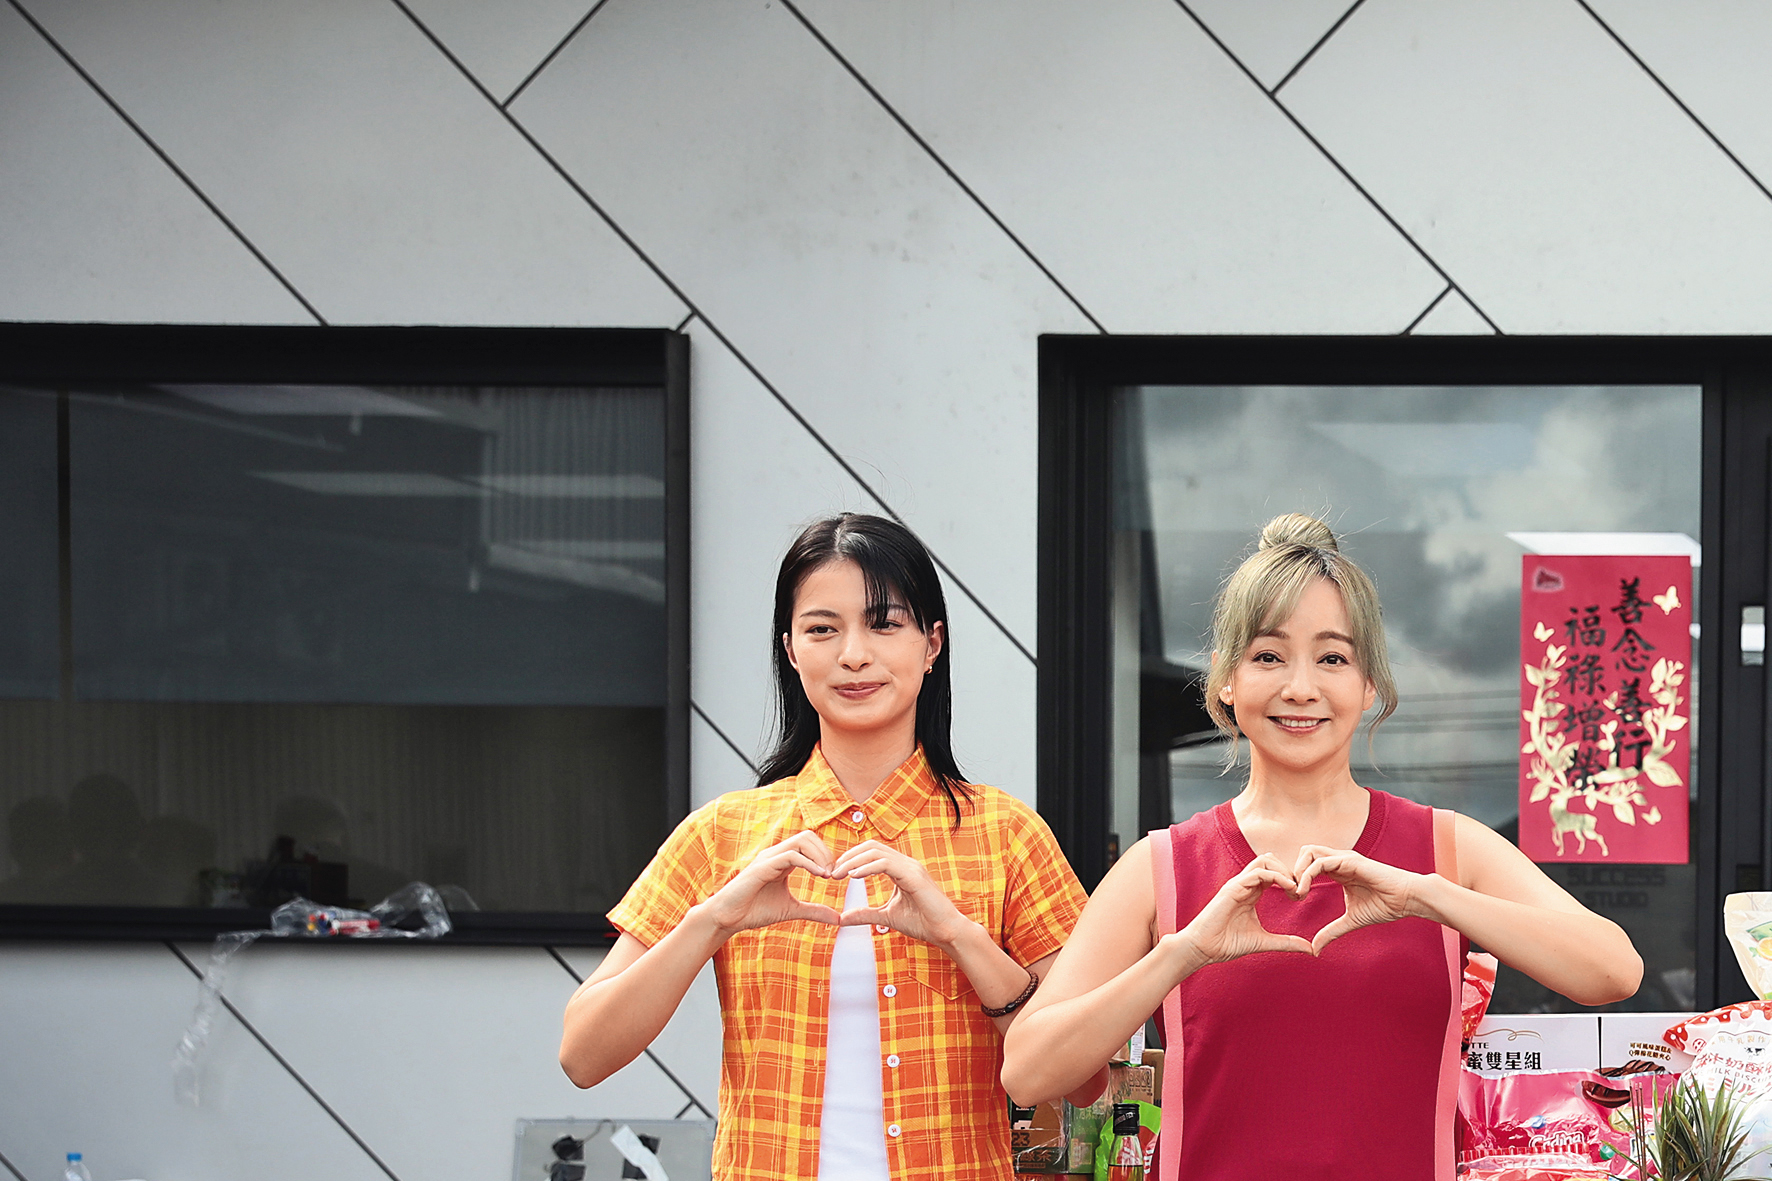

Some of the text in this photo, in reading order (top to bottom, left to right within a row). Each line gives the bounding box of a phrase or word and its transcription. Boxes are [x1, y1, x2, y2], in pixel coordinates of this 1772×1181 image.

[1564, 606, 1607, 792] 福祿增榮
[1611, 578, 1656, 772] 善念善行
